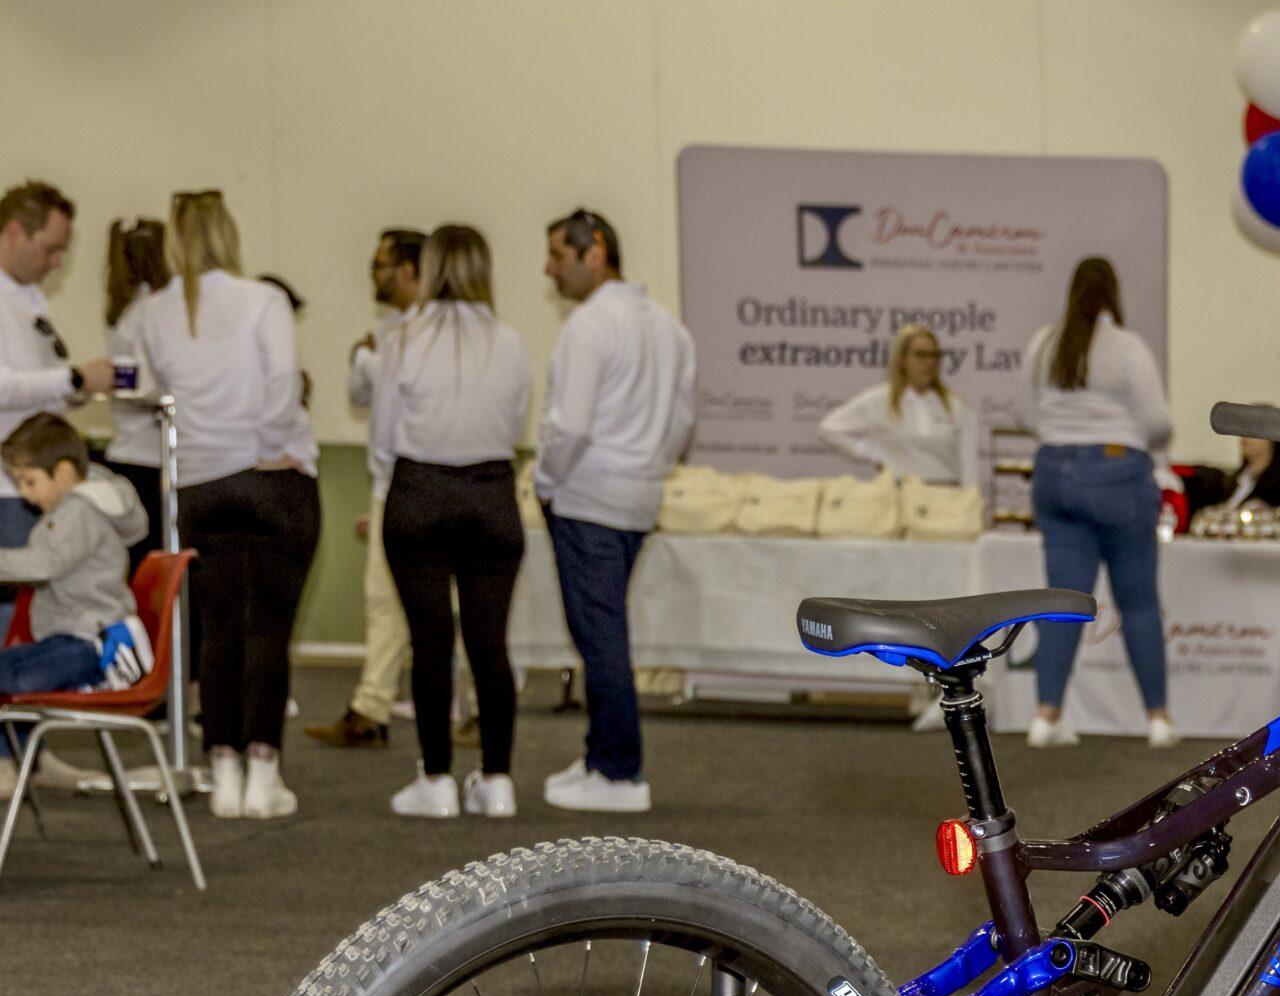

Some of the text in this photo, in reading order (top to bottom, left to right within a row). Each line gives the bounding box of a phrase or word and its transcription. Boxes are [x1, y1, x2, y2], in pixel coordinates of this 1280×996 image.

[737, 298, 996, 336] Ordinary people
[739, 340, 968, 375] extraordiry
[801, 618, 833, 641] YAMAHA
